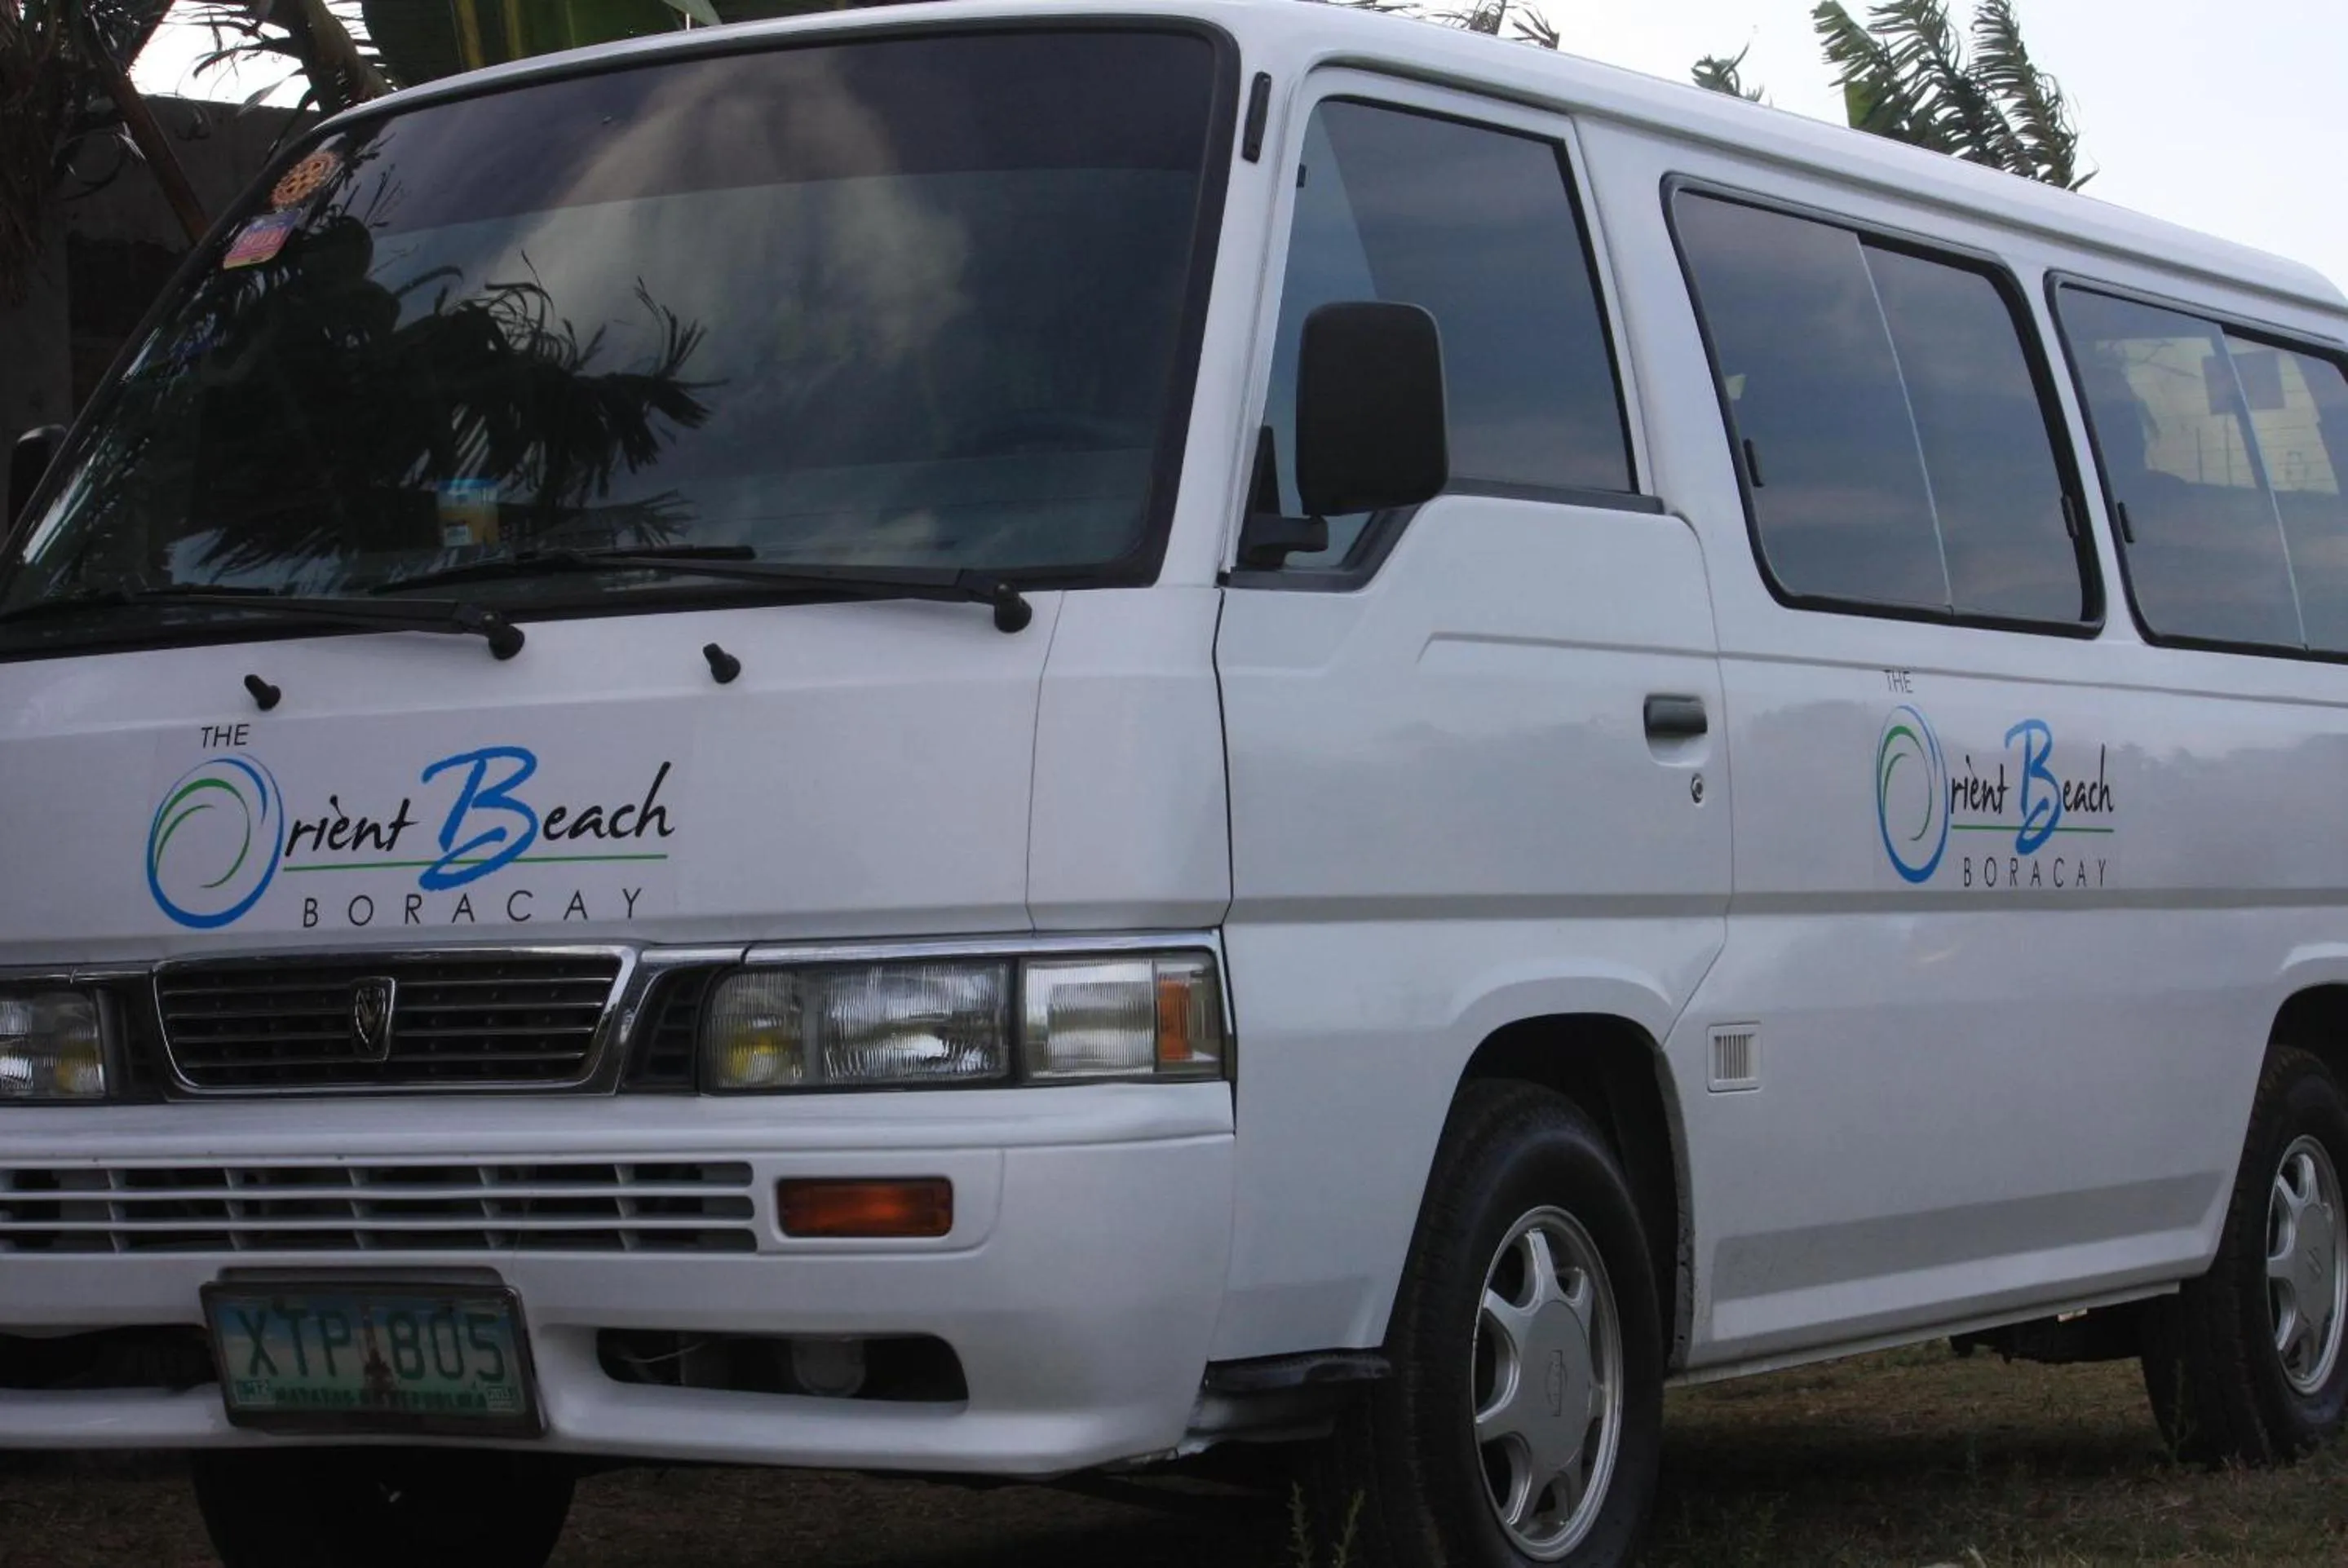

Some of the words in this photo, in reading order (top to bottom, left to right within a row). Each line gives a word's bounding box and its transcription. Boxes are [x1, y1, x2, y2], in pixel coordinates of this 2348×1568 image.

[1884, 669, 1913, 693] THE
[201, 723, 250, 748] THE
[2005, 718, 2115, 855] Beach
[418, 745, 675, 891] Beach
[1963, 857, 2107, 888] BORACAY
[303, 888, 641, 928] BORACAY
[238, 1306, 352, 1377] XTP
[386, 1308, 506, 1381] 805
